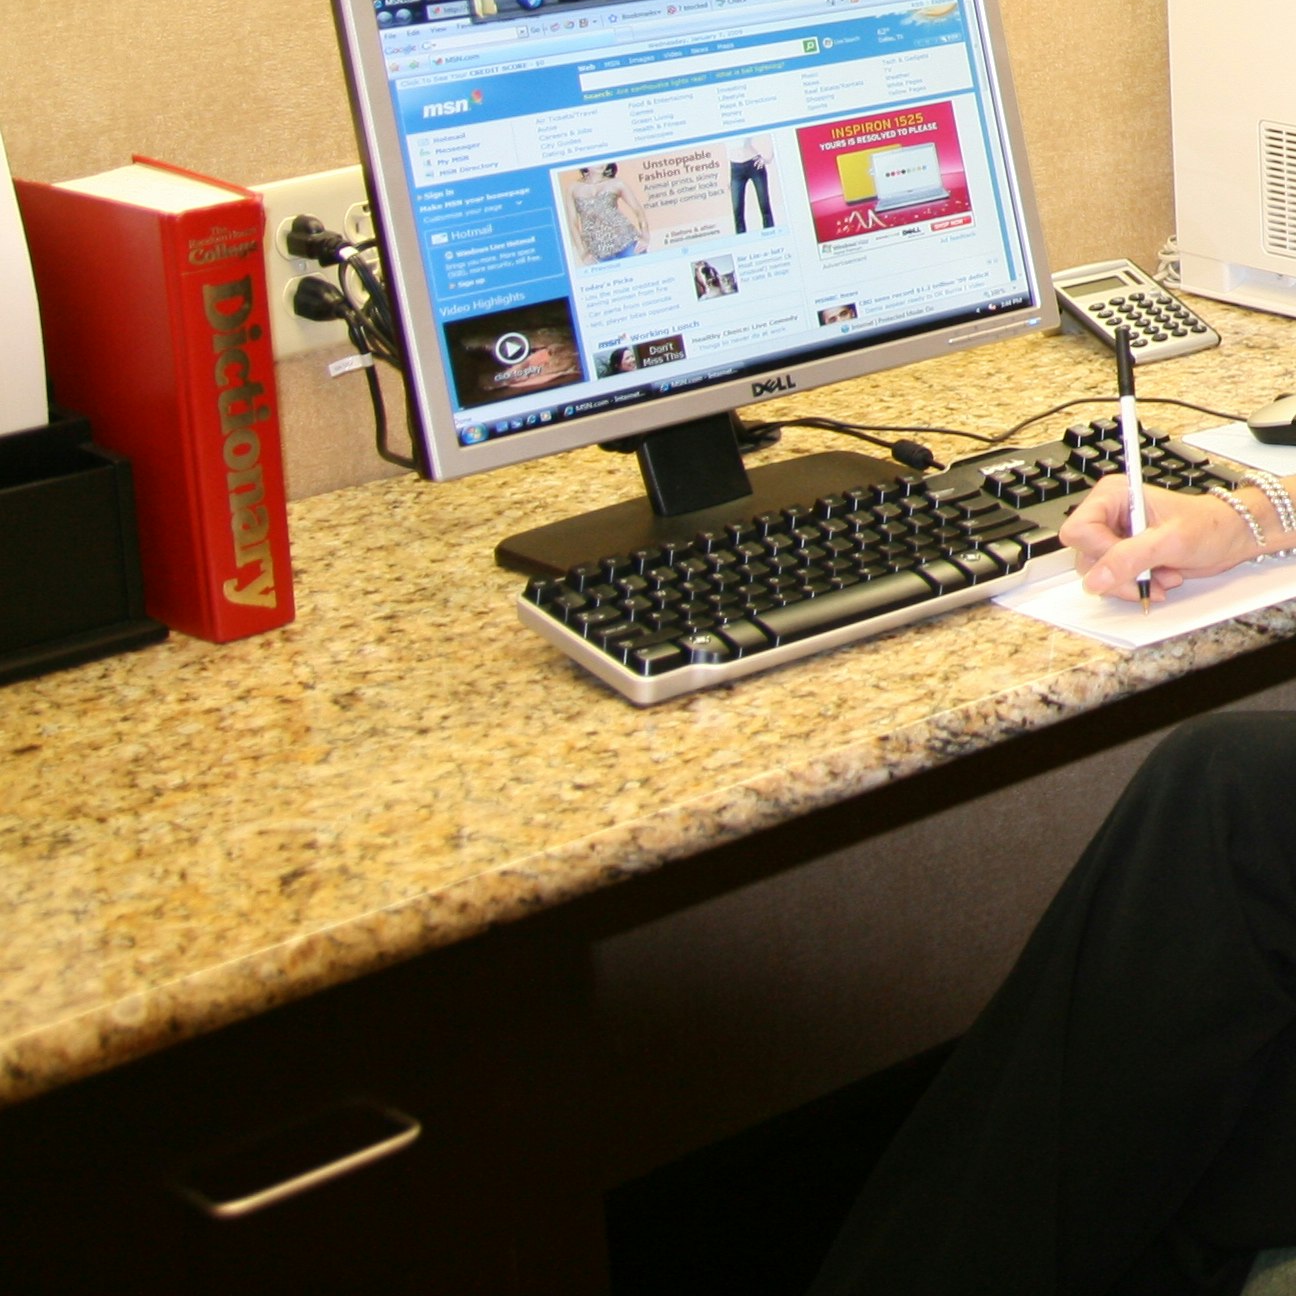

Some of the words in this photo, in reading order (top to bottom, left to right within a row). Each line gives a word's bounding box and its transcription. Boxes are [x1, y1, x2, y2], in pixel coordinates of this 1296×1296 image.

[421, 97, 470, 118] msn
[819, 139, 847, 151] YOURS
[856, 129, 897, 144] RESOLVED
[908, 121, 938, 134] PLEASE
[830, 118, 892, 139] INSPIRON
[893, 111, 924, 128] 1525
[637, 166, 681, 183] Fashion
[683, 159, 720, 174] Trends
[642, 149, 712, 172] Unstoppable
[642, 180, 669, 191] Animal
[670, 175, 694, 187] prints,
[695, 171, 718, 183] skinny
[486, 186, 530, 201] homepage
[450, 224, 493, 240] Hotmail
[187, 239, 258, 266] College
[439, 302, 470, 316] Video
[471, 290, 526, 312] Highlights
[629, 326, 669, 343] Working
[671, 319, 700, 332] Lunch
[642, 353, 664, 367] Miss
[664, 348, 684, 362] This
[648, 341, 674, 355] Don't
[751, 374, 797, 398] DELL
[575, 397, 609, 412] MSN.com
[202, 274, 277, 609] Dictionary
